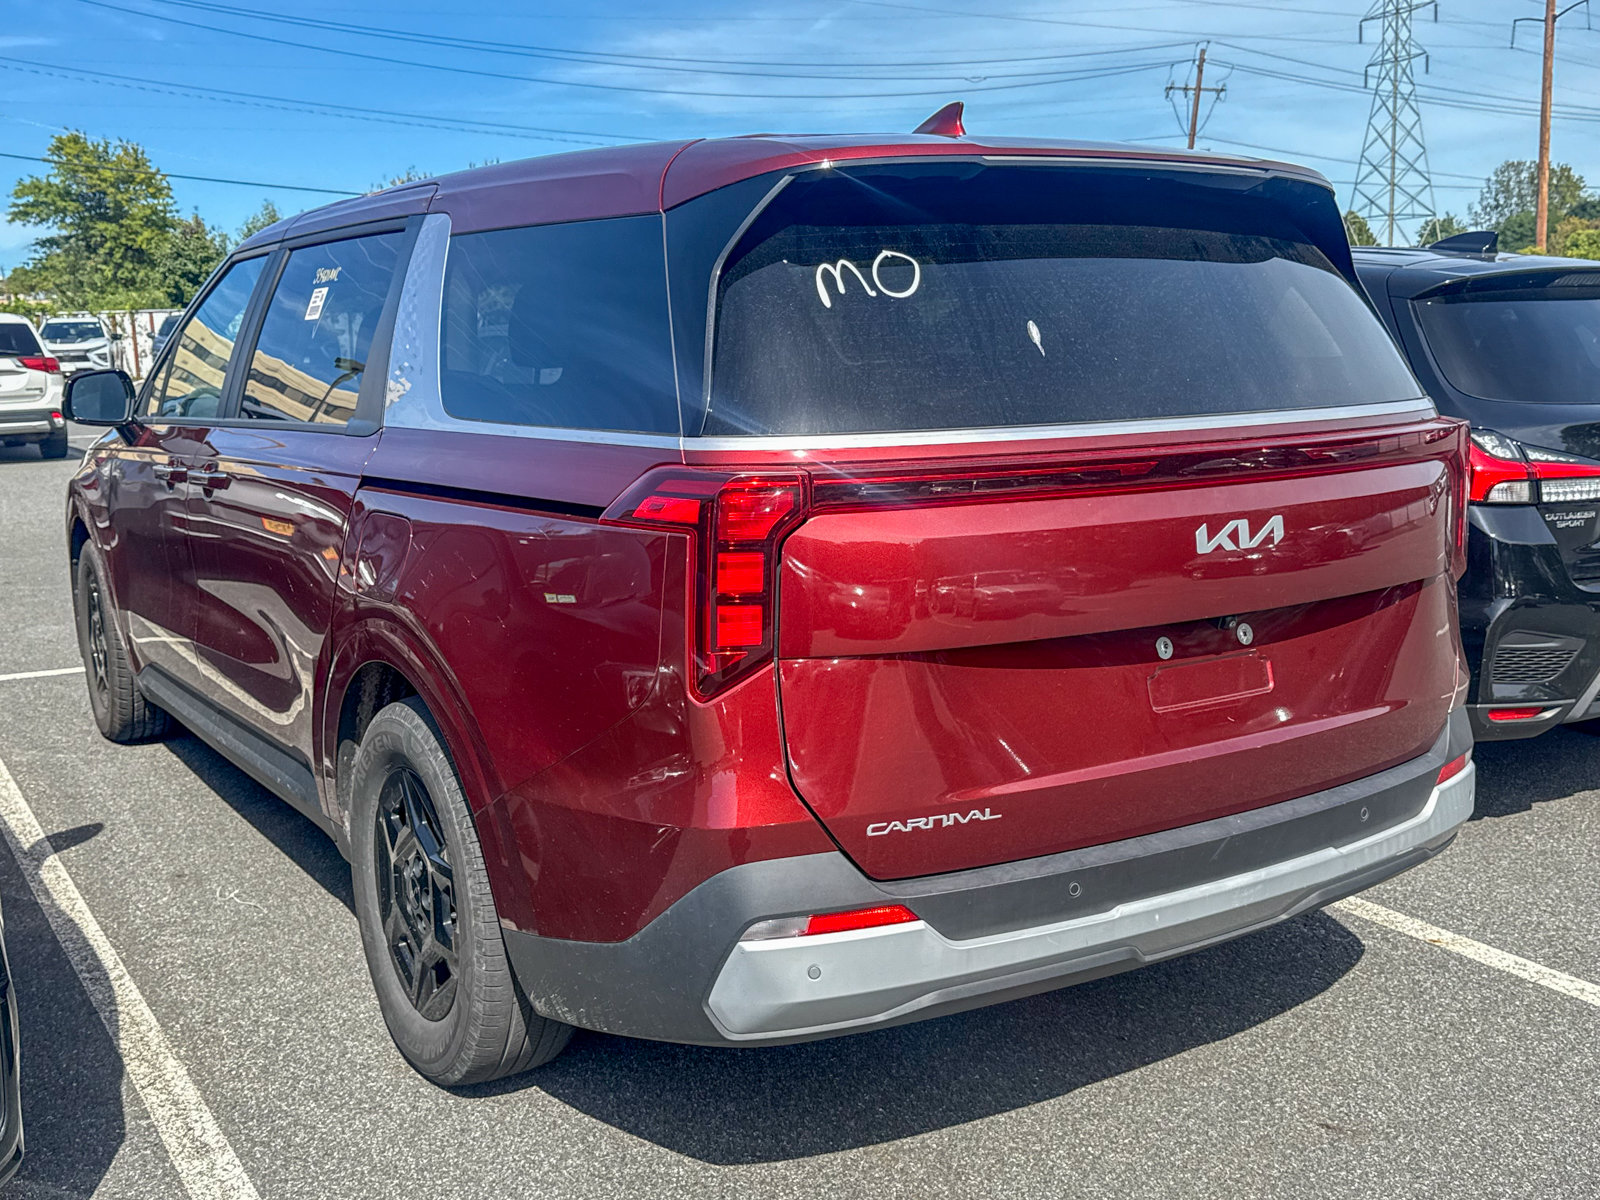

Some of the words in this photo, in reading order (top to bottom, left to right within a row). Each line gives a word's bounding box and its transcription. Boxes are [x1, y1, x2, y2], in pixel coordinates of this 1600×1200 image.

[1544, 510, 1596, 521] OUTLANDER
[1556, 519, 1585, 529] SPORT
[1195, 514, 1285, 554] KIA
[355, 733, 394, 787] NEXEN
[866, 807, 1002, 837] CARNIVAL
